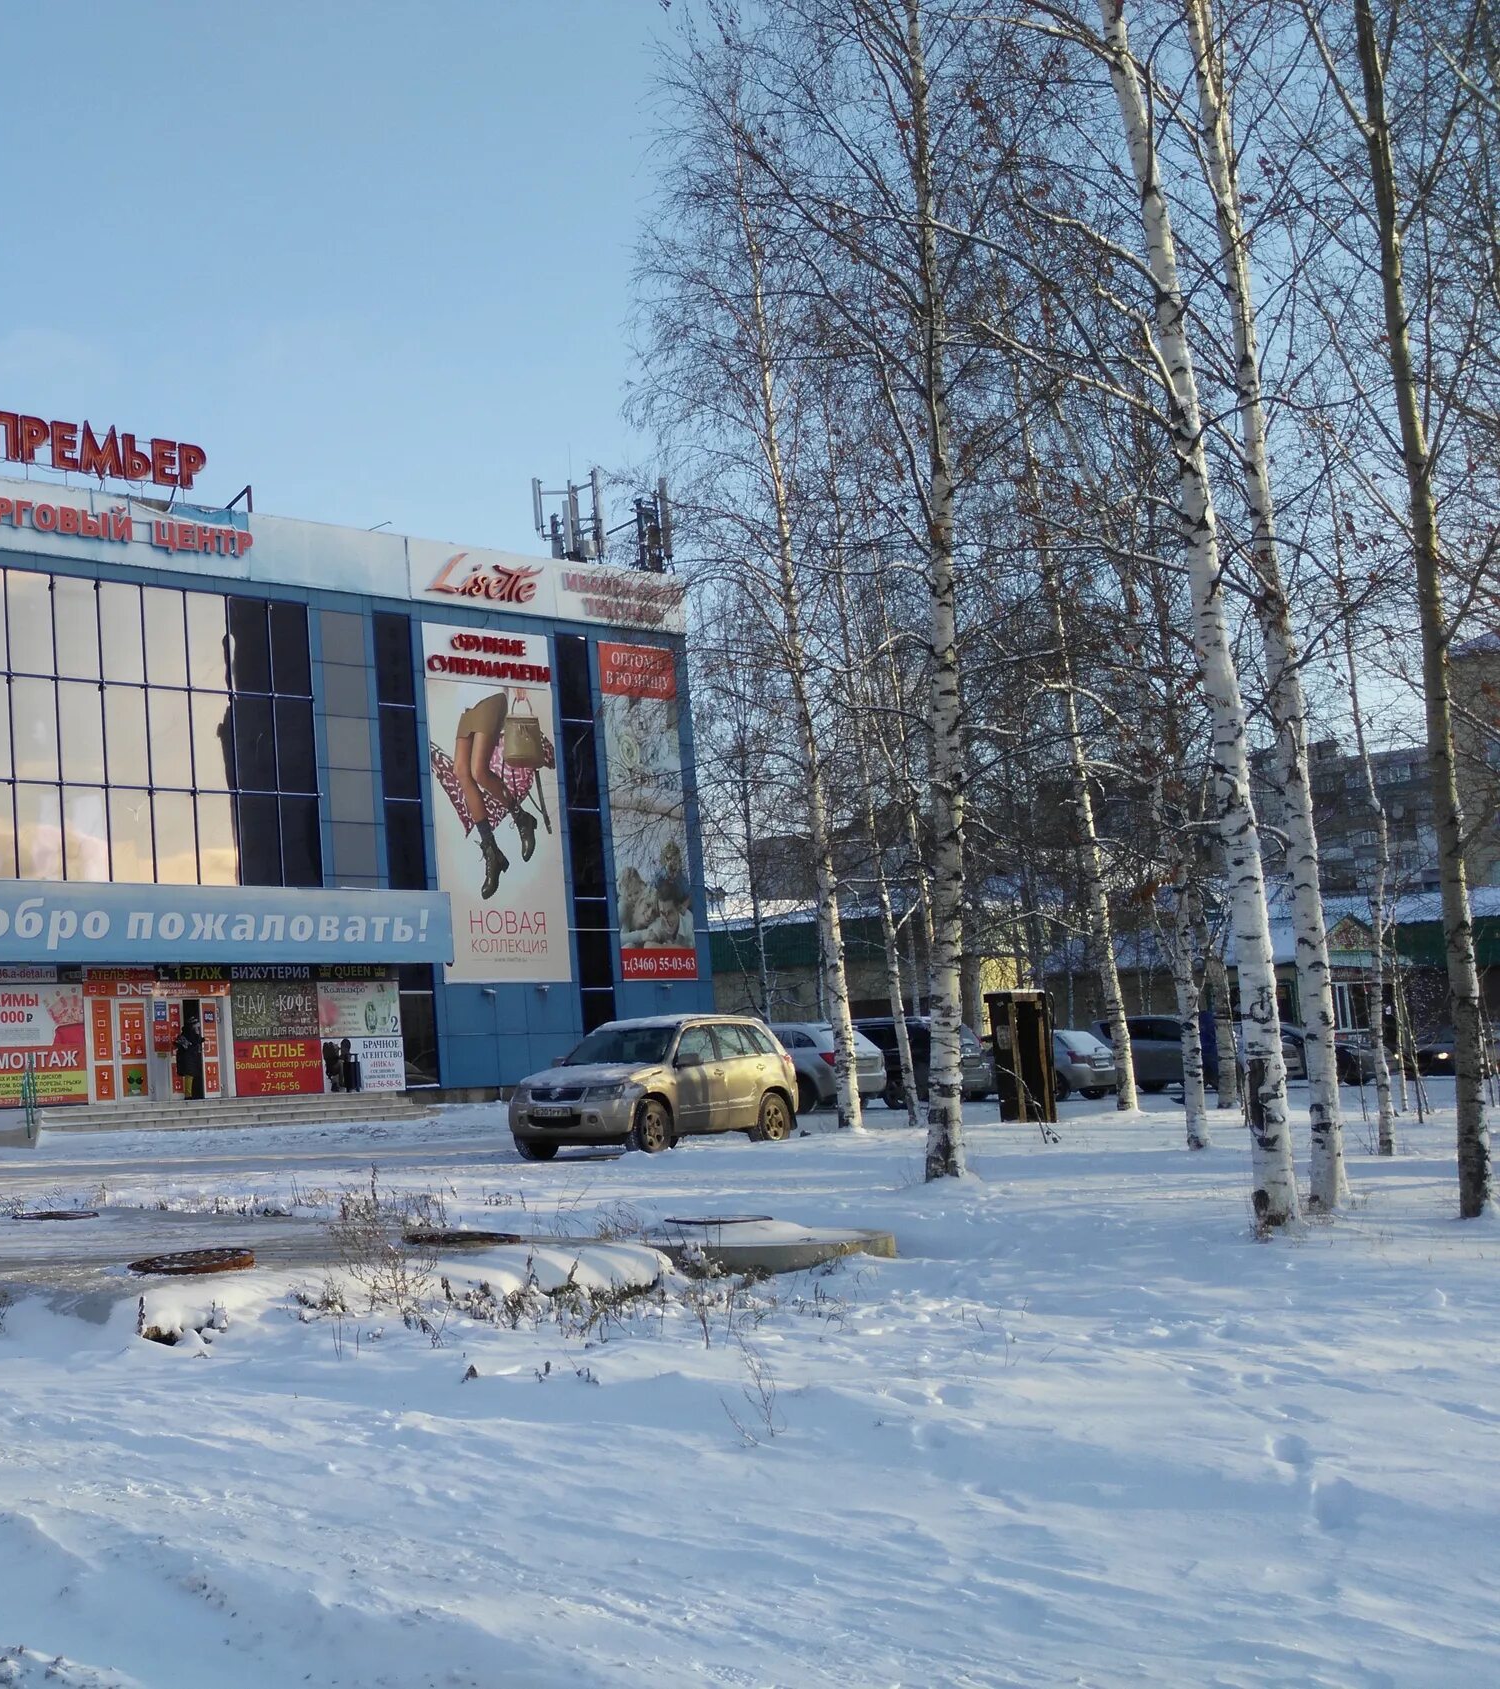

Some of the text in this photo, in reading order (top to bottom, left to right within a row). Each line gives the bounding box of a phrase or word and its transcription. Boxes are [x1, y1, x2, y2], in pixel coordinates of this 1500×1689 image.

[151, 519, 254, 557] ЦЕНТР
[425, 553, 543, 603] Lisette
[451, 633, 526, 657] ОБУВНЫЕ
[427, 653, 550, 682] СУПЕРМАРКЕТЫ
[606, 670, 613, 684] В
[126, 909, 430, 944] пожаловать!
[469, 910, 548, 935] НОВАЯ
[471, 939, 548, 955] КОЛЛЕКЦИЯ
[91, 970, 130, 980] АТЕЛЬЕ
[185, 967, 222, 980] ЭТАЖ
[231, 966, 371, 979] БИЖУТЕРИЯ QUEEN
[116, 983, 153, 996] DNS
[237, 993, 266, 1014] ЧАЙ
[0, 1010, 25, 1023] 000
[391, 1015, 399, 1032] 2
[252, 1043, 306, 1058] АТЕЛЬЕ
[363, 1040, 399, 1048] БРАЧНОЕ
[361, 1051, 402, 1059] АГЕНТСТВО
[236, 1060, 321, 1070] Большой спектр услуг
[261, 1081, 300, 1091] 27-46-56
